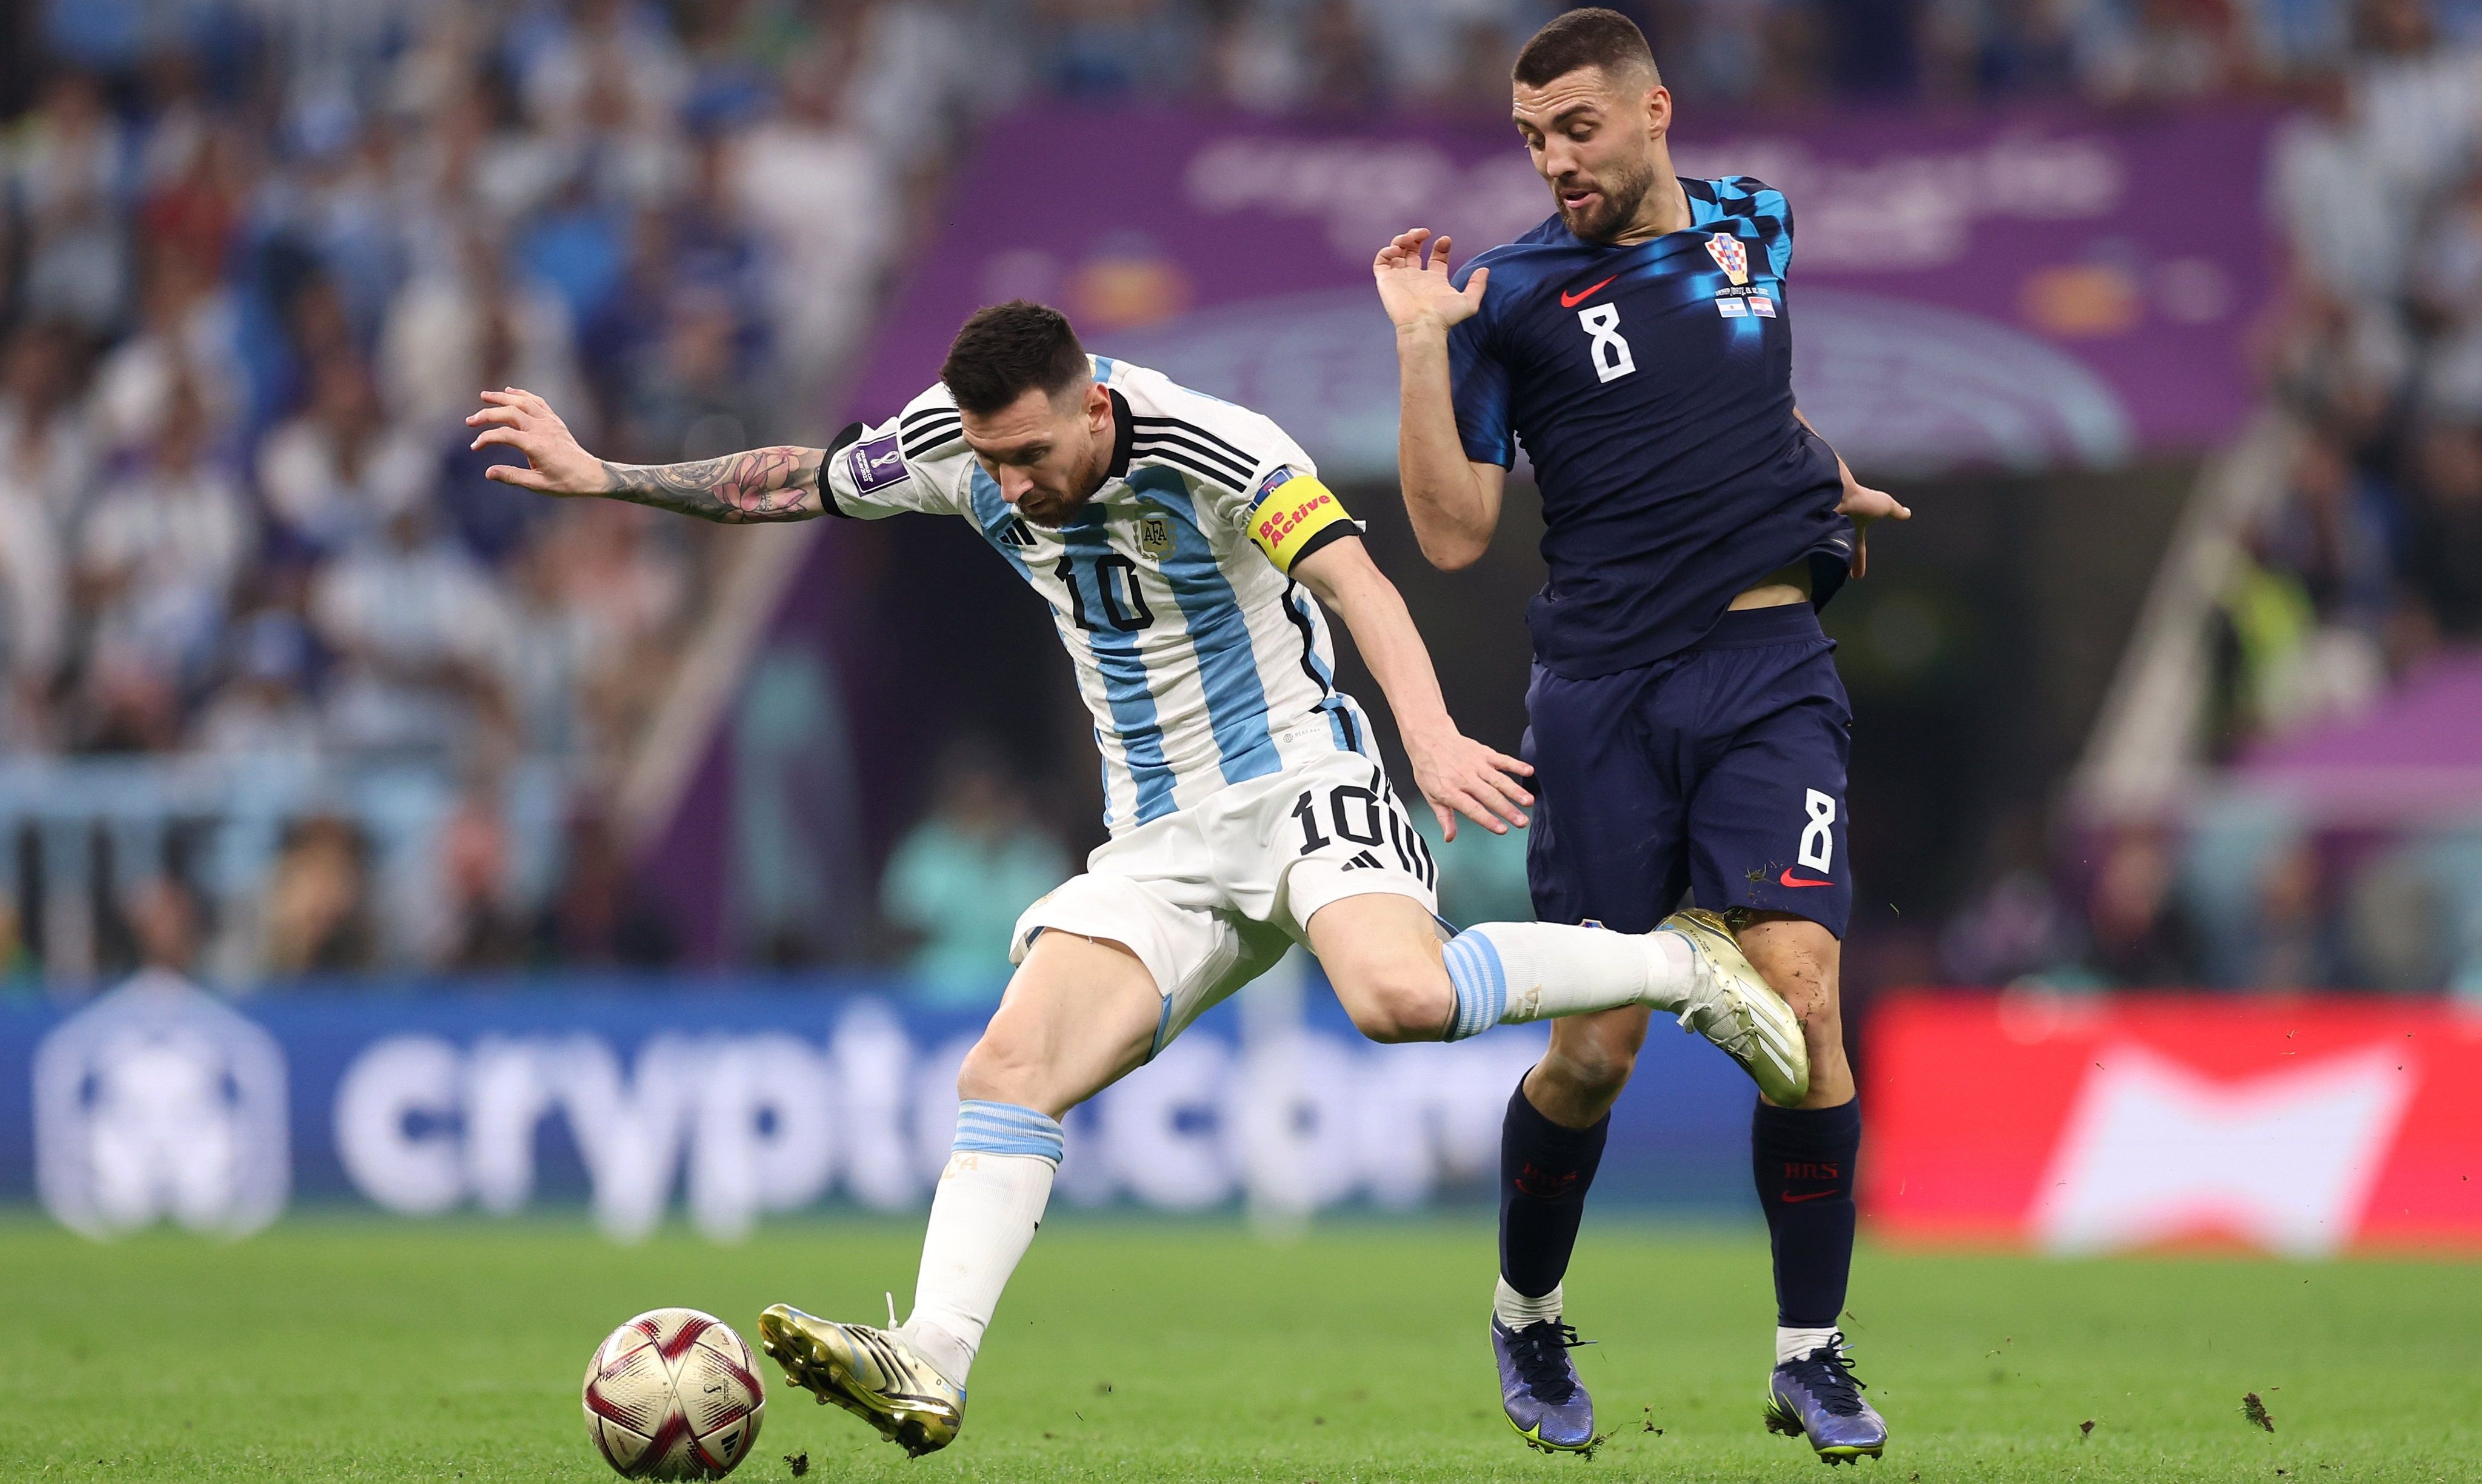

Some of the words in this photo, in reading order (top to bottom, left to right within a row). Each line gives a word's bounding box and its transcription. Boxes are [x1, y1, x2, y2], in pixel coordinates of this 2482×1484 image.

[1578, 302, 1636, 384] 8
[1144, 520, 1167, 545] AFA
[1259, 511, 1284, 541] Be
[1271, 495, 1330, 550] Active
[1054, 554, 1155, 632] 10
[1290, 785, 1384, 856] 10
[1798, 788, 1835, 874] 8
[330, 994, 1506, 1248] crypt.com
